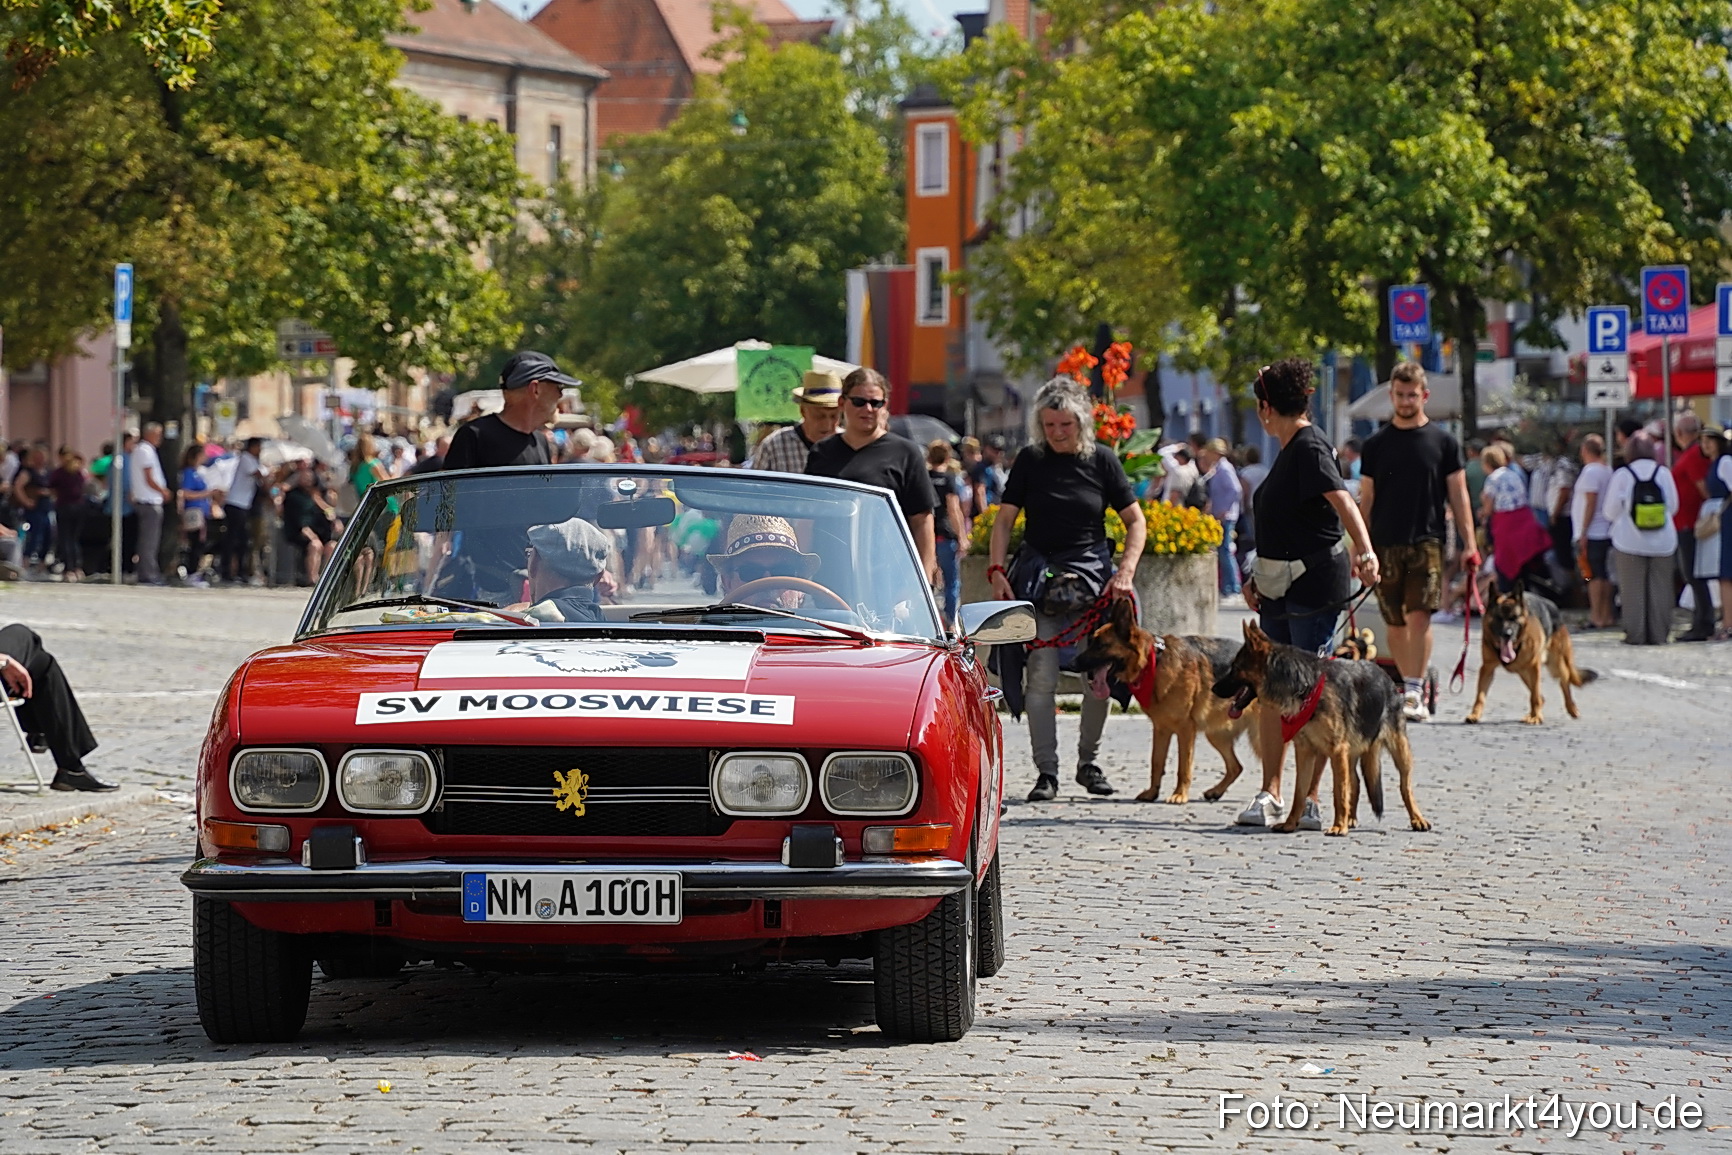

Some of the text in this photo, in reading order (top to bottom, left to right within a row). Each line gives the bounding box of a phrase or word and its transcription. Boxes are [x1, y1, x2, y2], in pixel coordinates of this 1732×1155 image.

[1395, 324, 1427, 338] TAXI
[1596, 313, 1619, 349] P
[1648, 314, 1686, 332] TAXI
[376, 694, 776, 717] SV MOOSWIESE
[487, 878, 532, 916] NM
[470, 902, 480, 913] D
